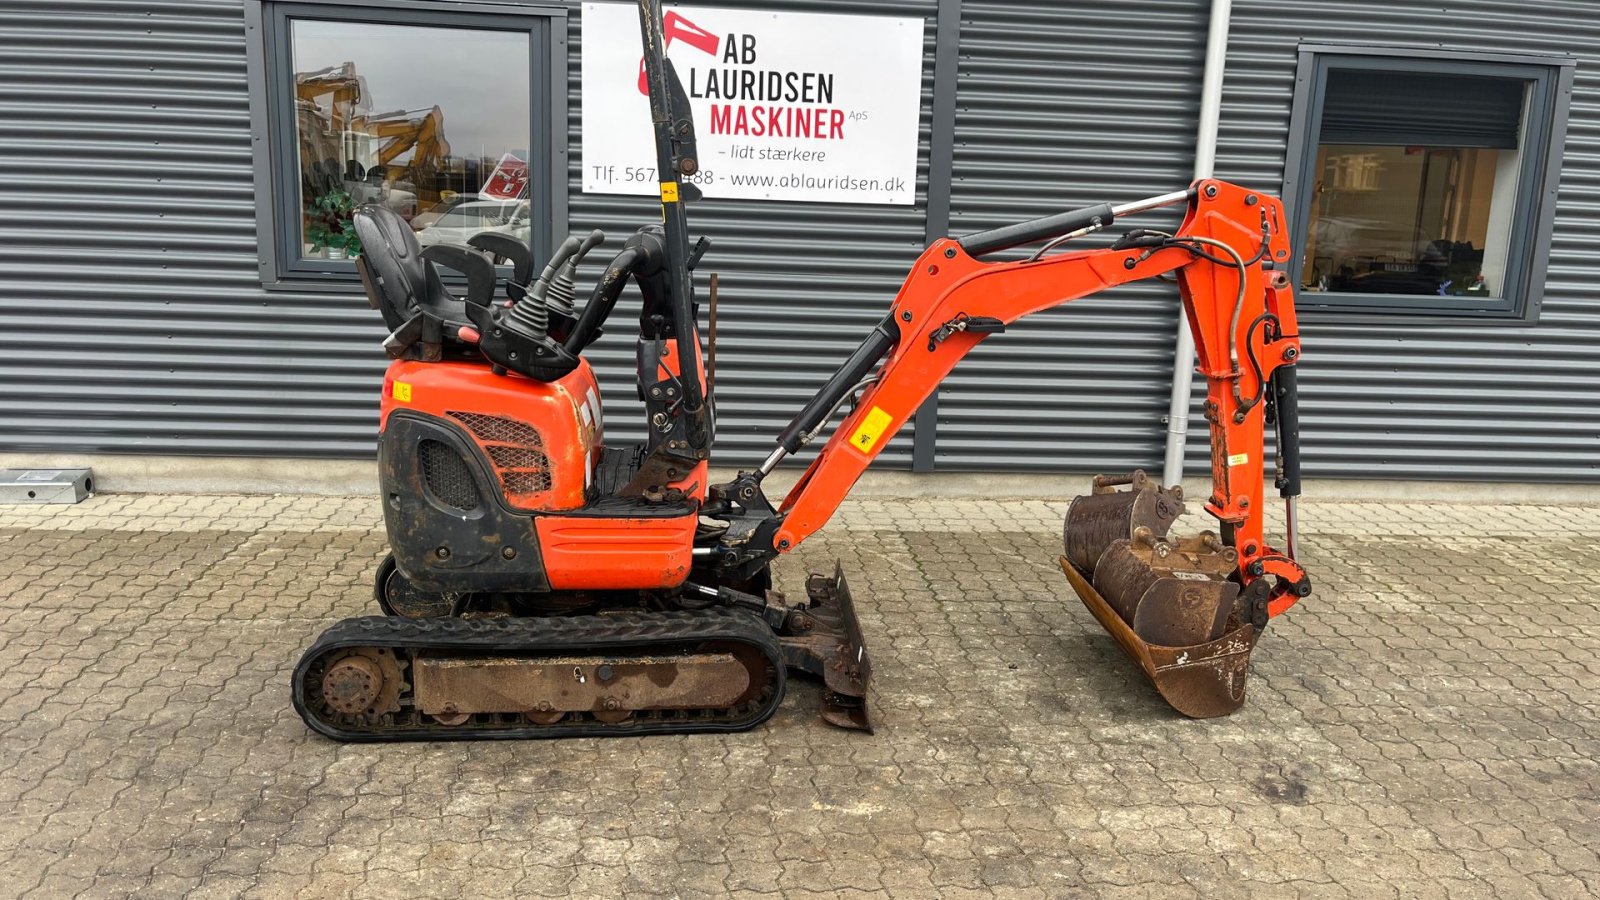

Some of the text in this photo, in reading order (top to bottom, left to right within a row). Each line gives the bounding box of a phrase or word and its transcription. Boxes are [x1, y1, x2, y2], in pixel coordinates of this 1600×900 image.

[723, 33, 757, 65] AB
[690, 67, 834, 104] LAURIDSEN
[710, 104, 868, 140] MASKINER ApS
[731, 145, 755, 160] lidt
[758, 147, 826, 162] stærkere
[592, 165, 619, 184] Tlf.
[625, 167, 660, 182] 567
[730, 173, 905, 192] www.ablauridsen.dk
